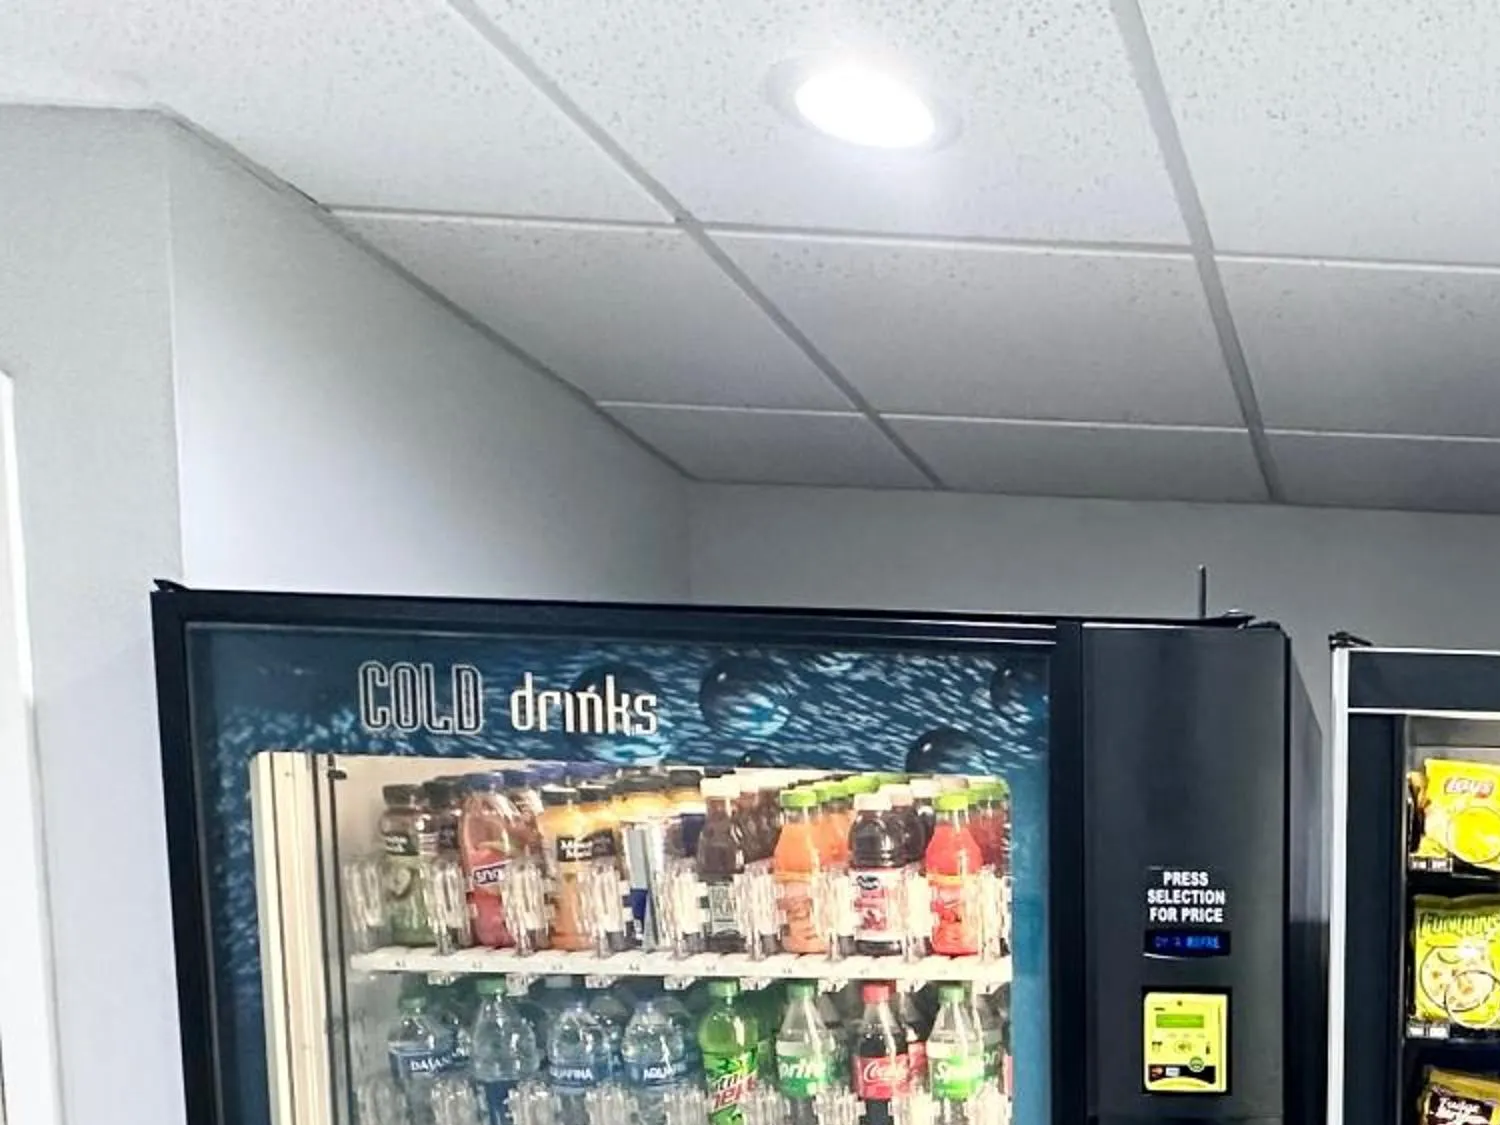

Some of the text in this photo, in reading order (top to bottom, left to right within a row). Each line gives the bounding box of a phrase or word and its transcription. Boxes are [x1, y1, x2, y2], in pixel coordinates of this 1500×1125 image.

[357, 660, 658, 736] COLD drinks
[1163, 871, 1209, 887] PRESS
[1147, 889, 1226, 905] SELECTION
[1149, 906, 1224, 923] FOR PRICE
